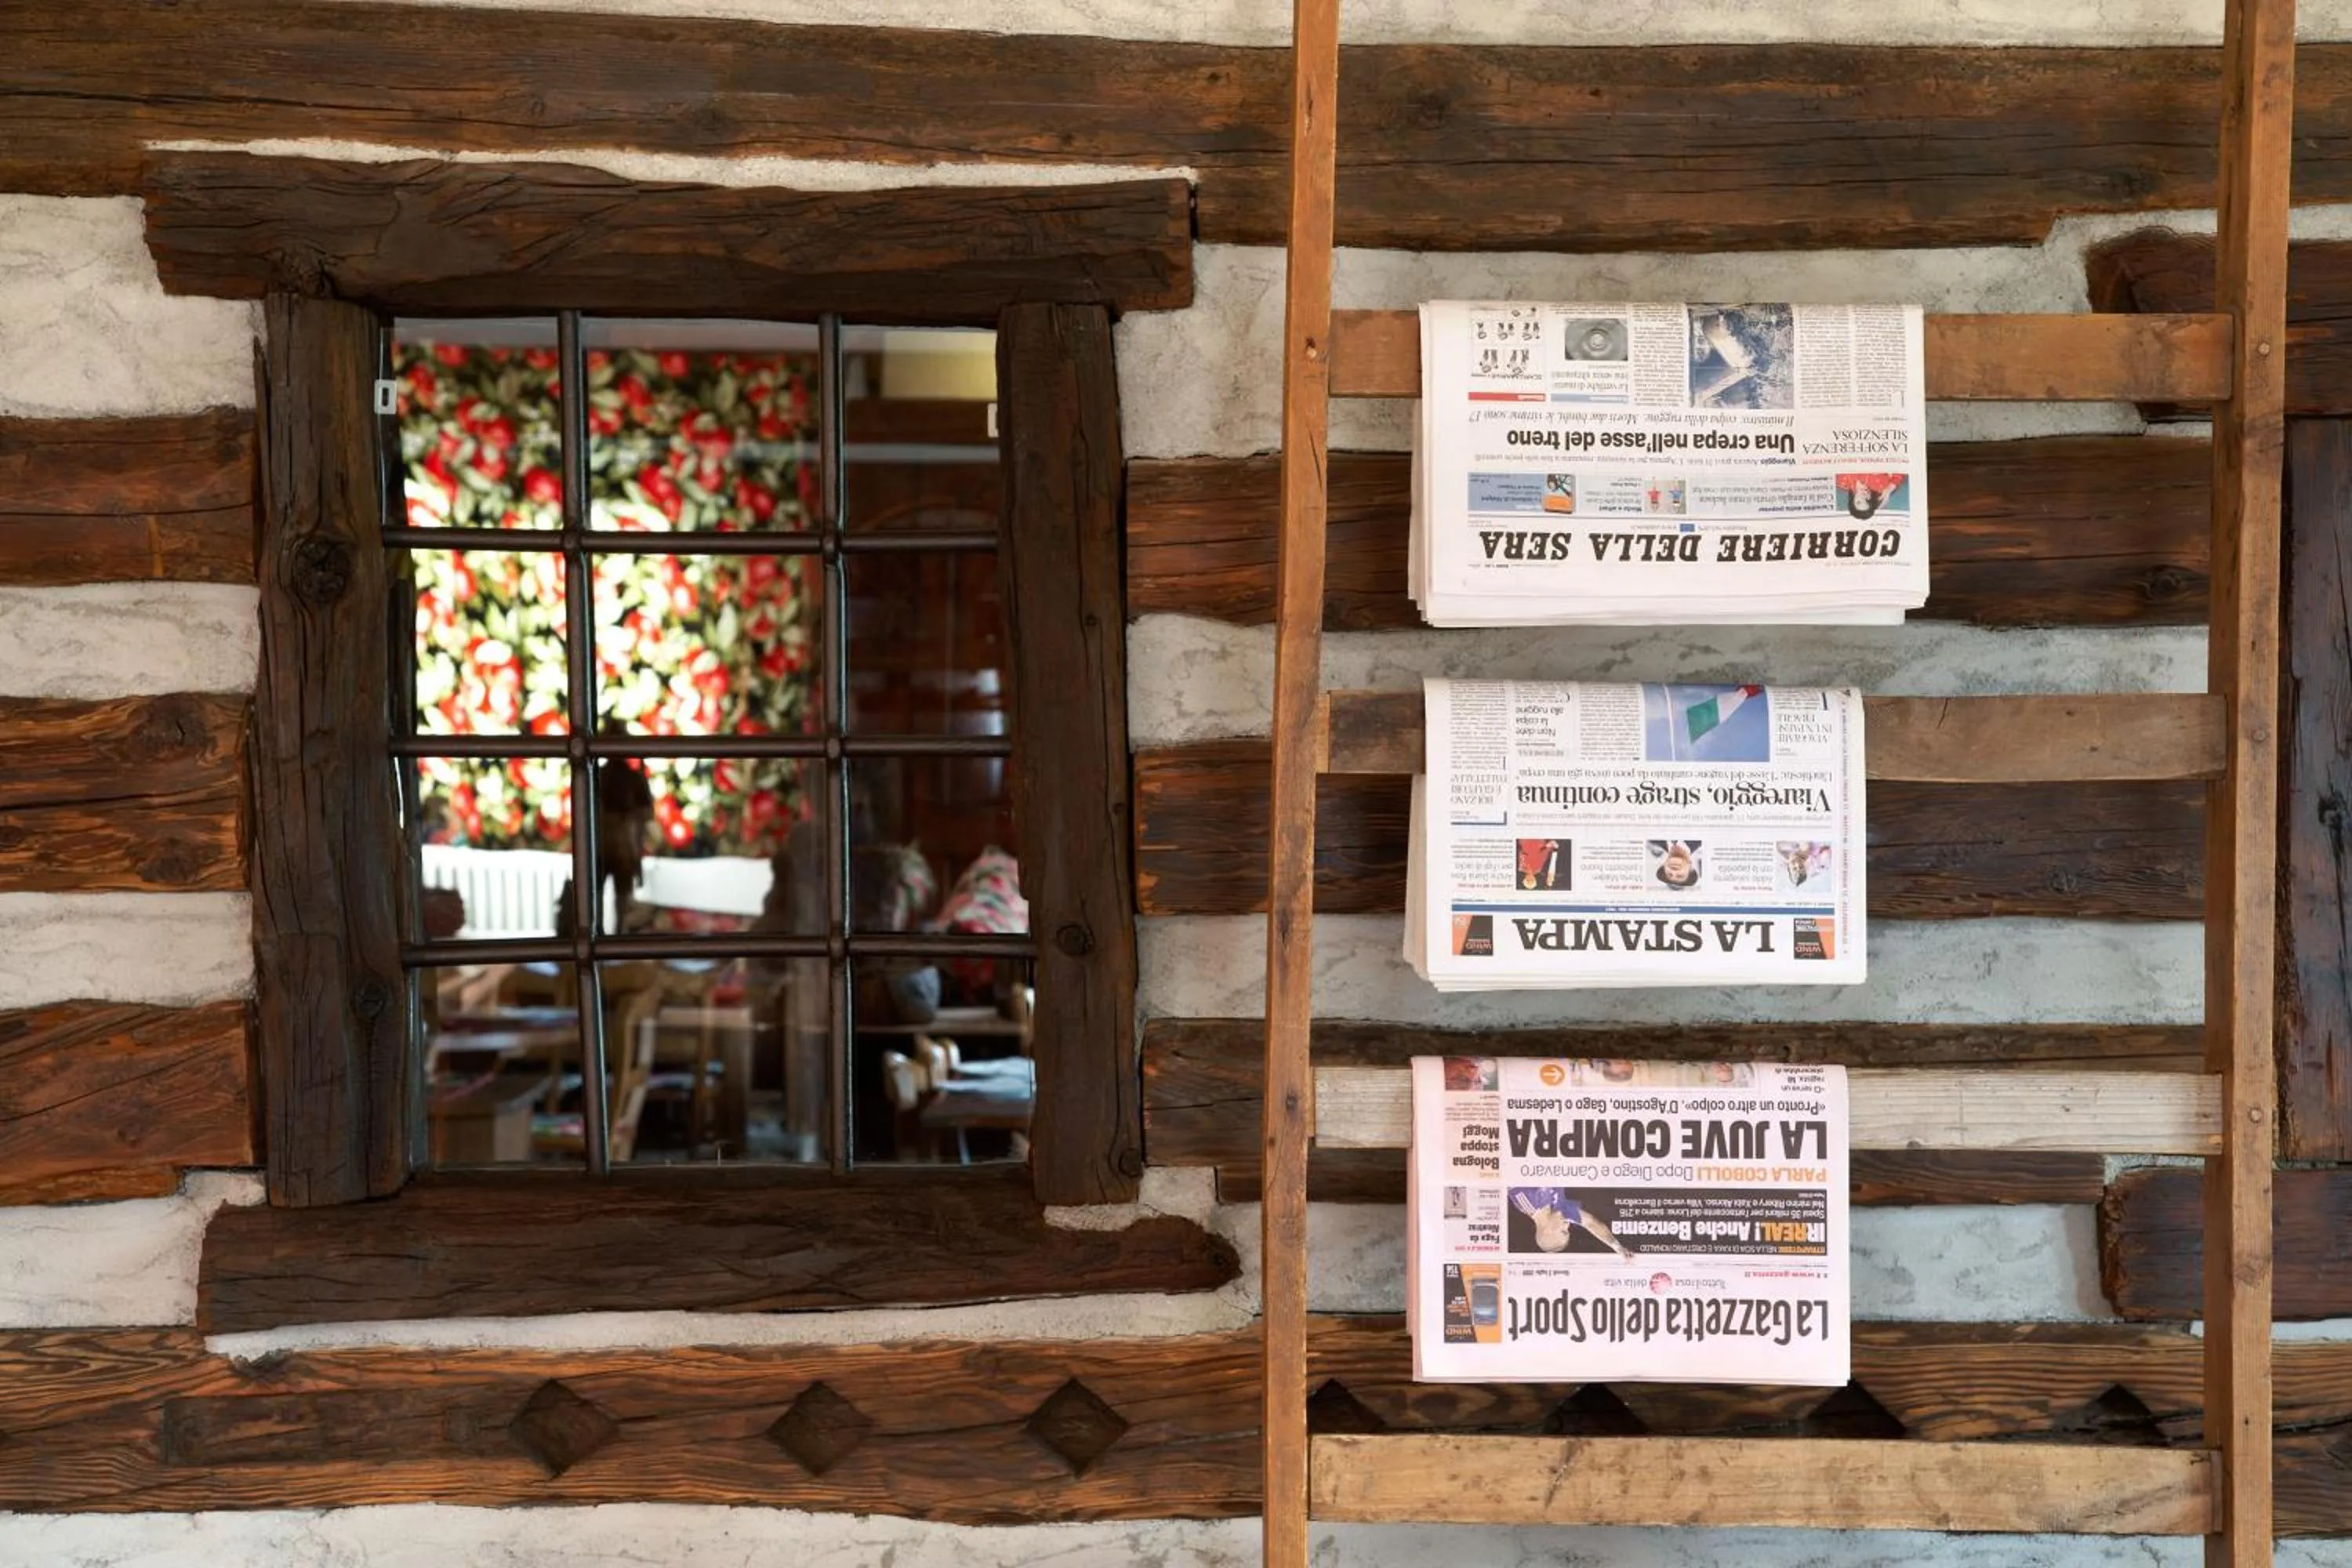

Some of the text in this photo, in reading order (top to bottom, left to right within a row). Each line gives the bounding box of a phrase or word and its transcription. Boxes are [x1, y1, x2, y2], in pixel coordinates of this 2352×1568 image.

[1468, 410, 1481, 422] 17
[1483, 410, 1508, 419] sono
[1509, 410, 1542, 423] vittime
[1545, 412, 1555, 423] le
[1589, 412, 1607, 424] due
[1609, 412, 1639, 425] Morti
[1684, 414, 1708, 426] della
[1710, 413, 1737, 426] colpa
[1785, 416, 1794, 426] Il
[1831, 429, 1907, 441] SILENZIOSA
[1507, 430, 1795, 453] Una crepa nell'asse del treno
[1802, 441, 1907, 455] LA SOFFERENZA
[1760, 456, 1796, 466] Viareggio
[1479, 529, 1900, 562] CORRIERE DELLA SERA
[1515, 705, 1564, 716] alla ruggine
[1515, 716, 1539, 725] colpa
[1537, 728, 1556, 737] Non
[1567, 768, 1583, 779] già
[1613, 768, 1635, 778] poco
[1696, 769, 1730, 779] vagone
[1730, 771, 1744, 782] del
[1516, 781, 1831, 812] Viareggio, strage continua
[1512, 918, 1775, 953] LA STAMPA
[1507, 1098, 1563, 1113] Ledesma
[1564, 1098, 1573, 1109] o
[1575, 1097, 1606, 1113] Gago
[1610, 1097, 1679, 1113] D'Agostino,
[1725, 1099, 1757, 1114] altro
[1759, 1099, 1774, 1110] un
[1777, 1099, 1825, 1115] «Pronto
[1462, 1124, 1500, 1139] Moggi
[1505, 1119, 1828, 1160] LA JUVE COMPRA
[1460, 1139, 1499, 1152] stoppa
[1452, 1155, 1499, 1170] Bologna
[1520, 1163, 1828, 1183] PARLA COBOLLI Dopo Diego e Cannavaro
[1614, 1199, 1657, 1207] Barcellona
[1686, 1199, 1703, 1207] Villa
[1733, 1199, 1751, 1207] Xabi
[1759, 1198, 1785, 1208] Ribery
[1785, 1200, 1810, 1208] mirino
[1812, 1200, 1824, 1208] Nel
[1690, 1208, 1702, 1218] del
[1750, 1208, 1764, 1217] per
[1765, 1210, 1790, 1218] milioni
[1791, 1210, 1801, 1218] 35
[1802, 1208, 1825, 1219] Spesi
[1468, 1224, 1500, 1233] Alcatraz
[1610, 1220, 1825, 1243] IRREAL! Anche Benzema
[1469, 1233, 1500, 1244] Fuga da
[1604, 1278, 1622, 1288] vita
[1624, 1278, 1647, 1289] della
[1675, 1278, 1694, 1287] rosa
[1704, 1279, 1726, 1290] Tutto
[1507, 1288, 1587, 1343] Sport
[1592, 1297, 1660, 1343] dello
[1796, 1299, 1829, 1341] La
[1666, 1298, 1791, 1346] Gazzetta
